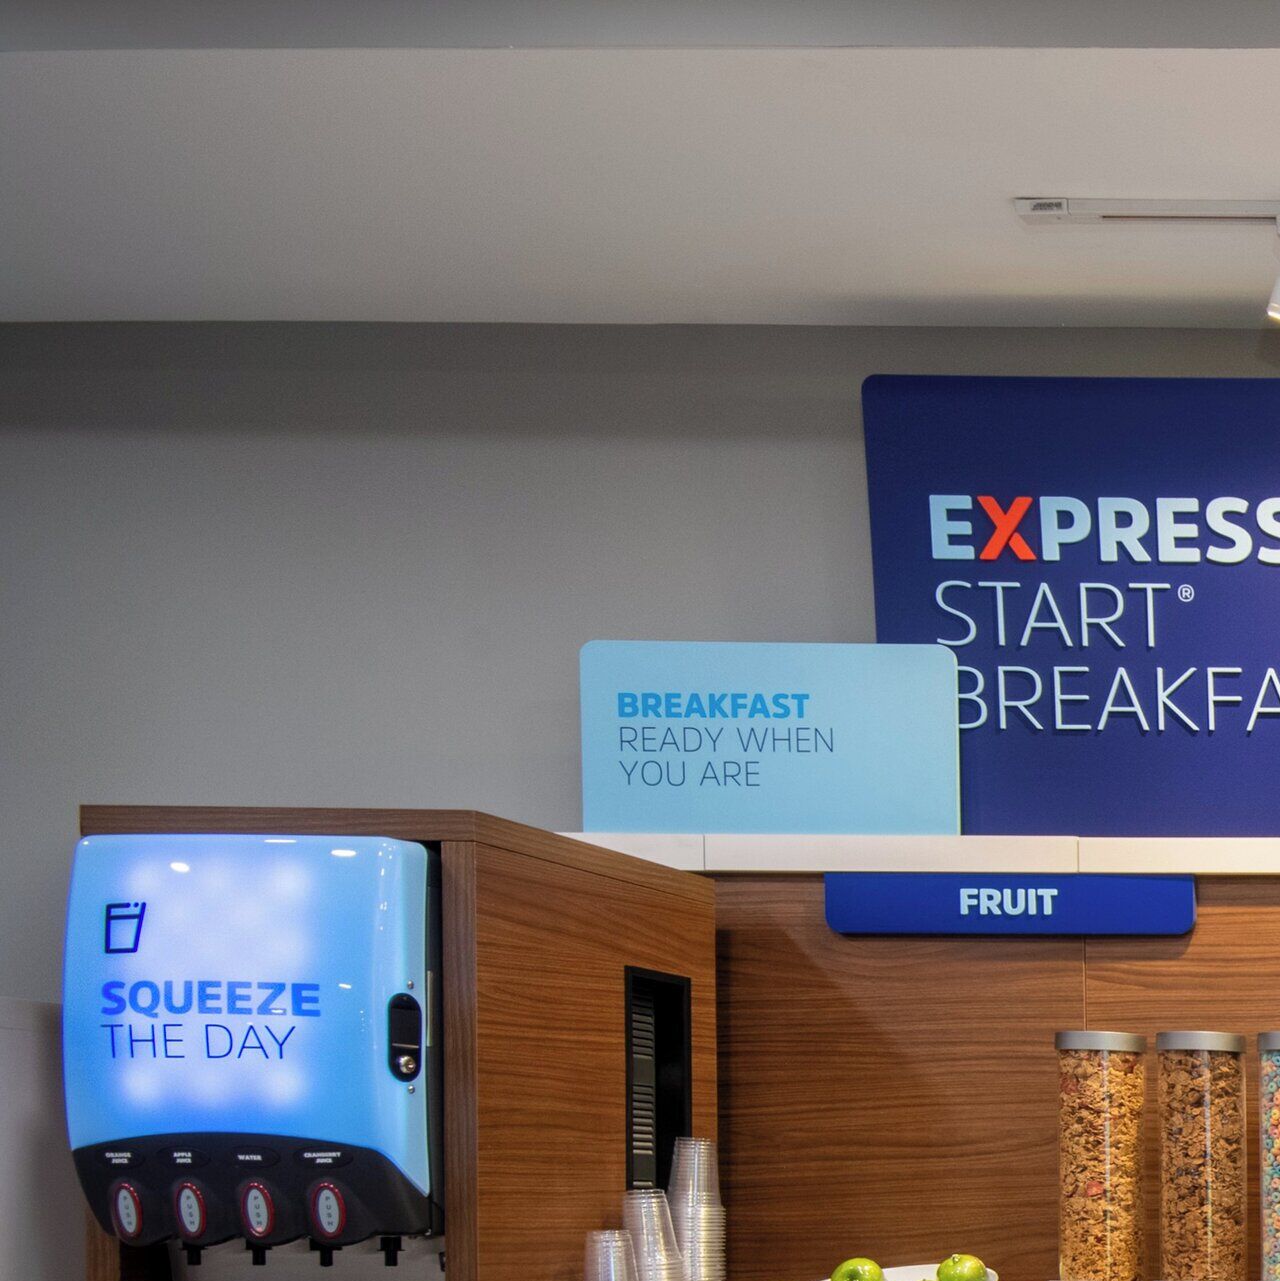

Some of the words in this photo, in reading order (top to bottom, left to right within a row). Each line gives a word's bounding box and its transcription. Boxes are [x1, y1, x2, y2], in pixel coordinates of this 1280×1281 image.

[617, 692, 810, 719] BREAKFAST
[618, 726, 724, 753] READY
[736, 727, 835, 753] WHEN
[618, 760, 686, 787] YOU
[700, 761, 761, 787] ARE
[959, 888, 1059, 916] FRUIT
[101, 980, 321, 1018] SQUEEZE
[100, 1023, 185, 1059] THE
[205, 1023, 296, 1060] DAY
